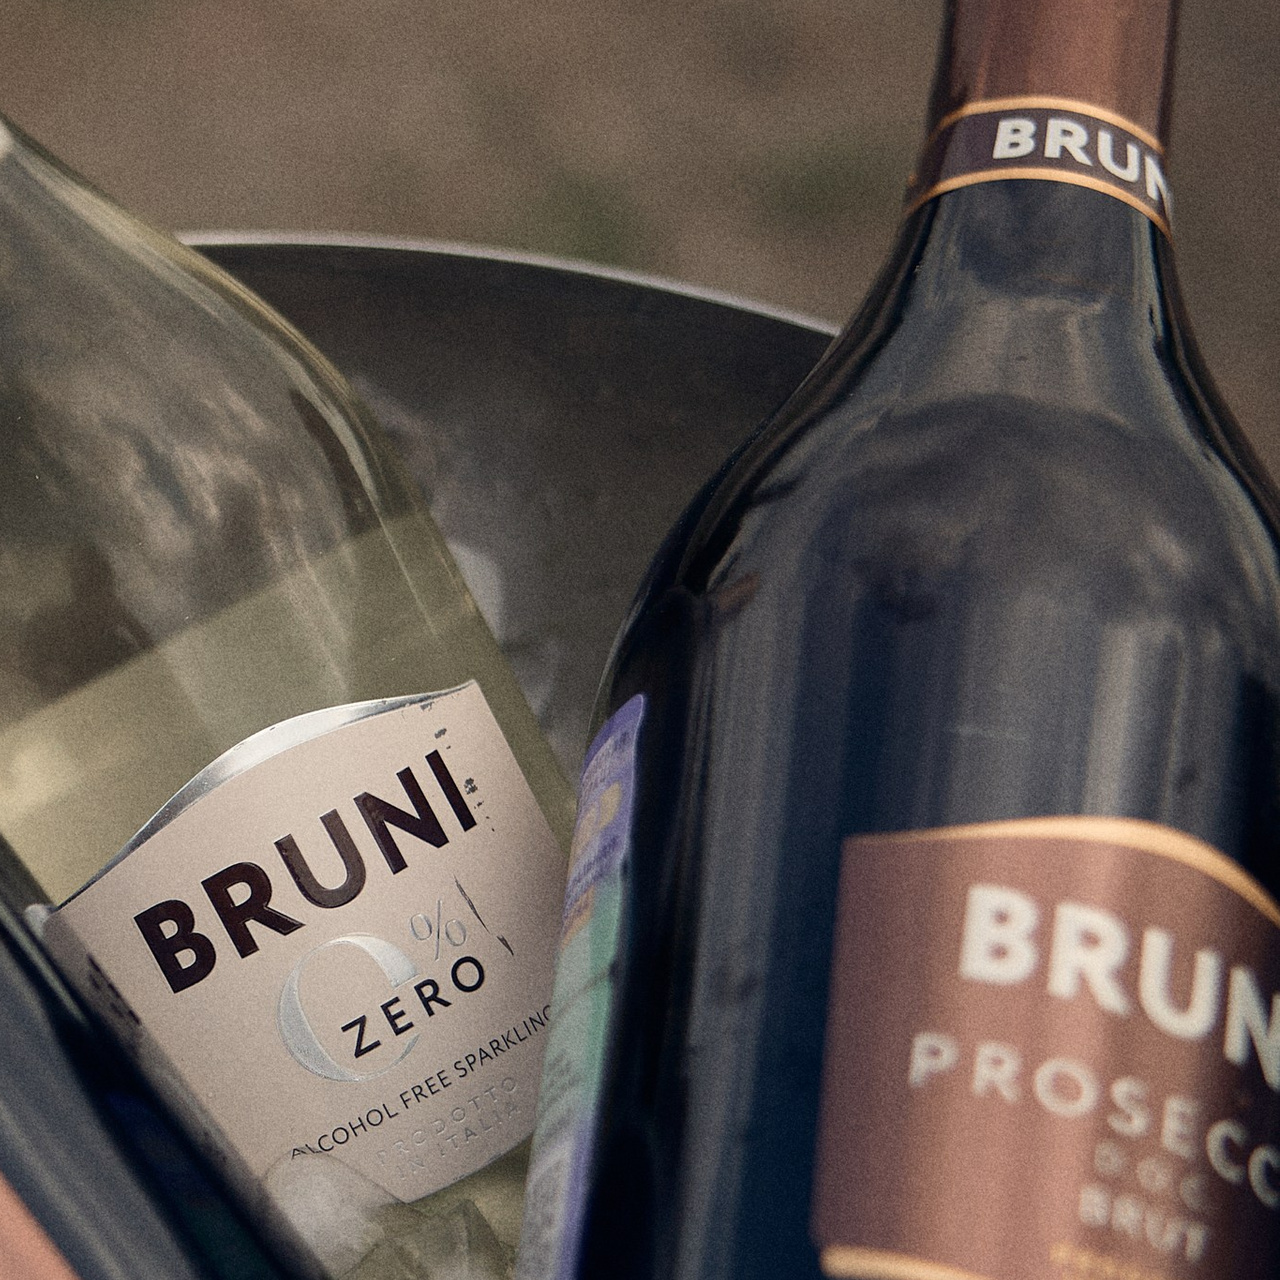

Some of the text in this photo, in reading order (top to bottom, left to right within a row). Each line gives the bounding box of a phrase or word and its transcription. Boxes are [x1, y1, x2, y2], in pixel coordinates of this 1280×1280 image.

[133, 749, 477, 994] BRUNI
[341, 956, 485, 1058] ZERO
[400, 1070, 452, 1109] FREE
